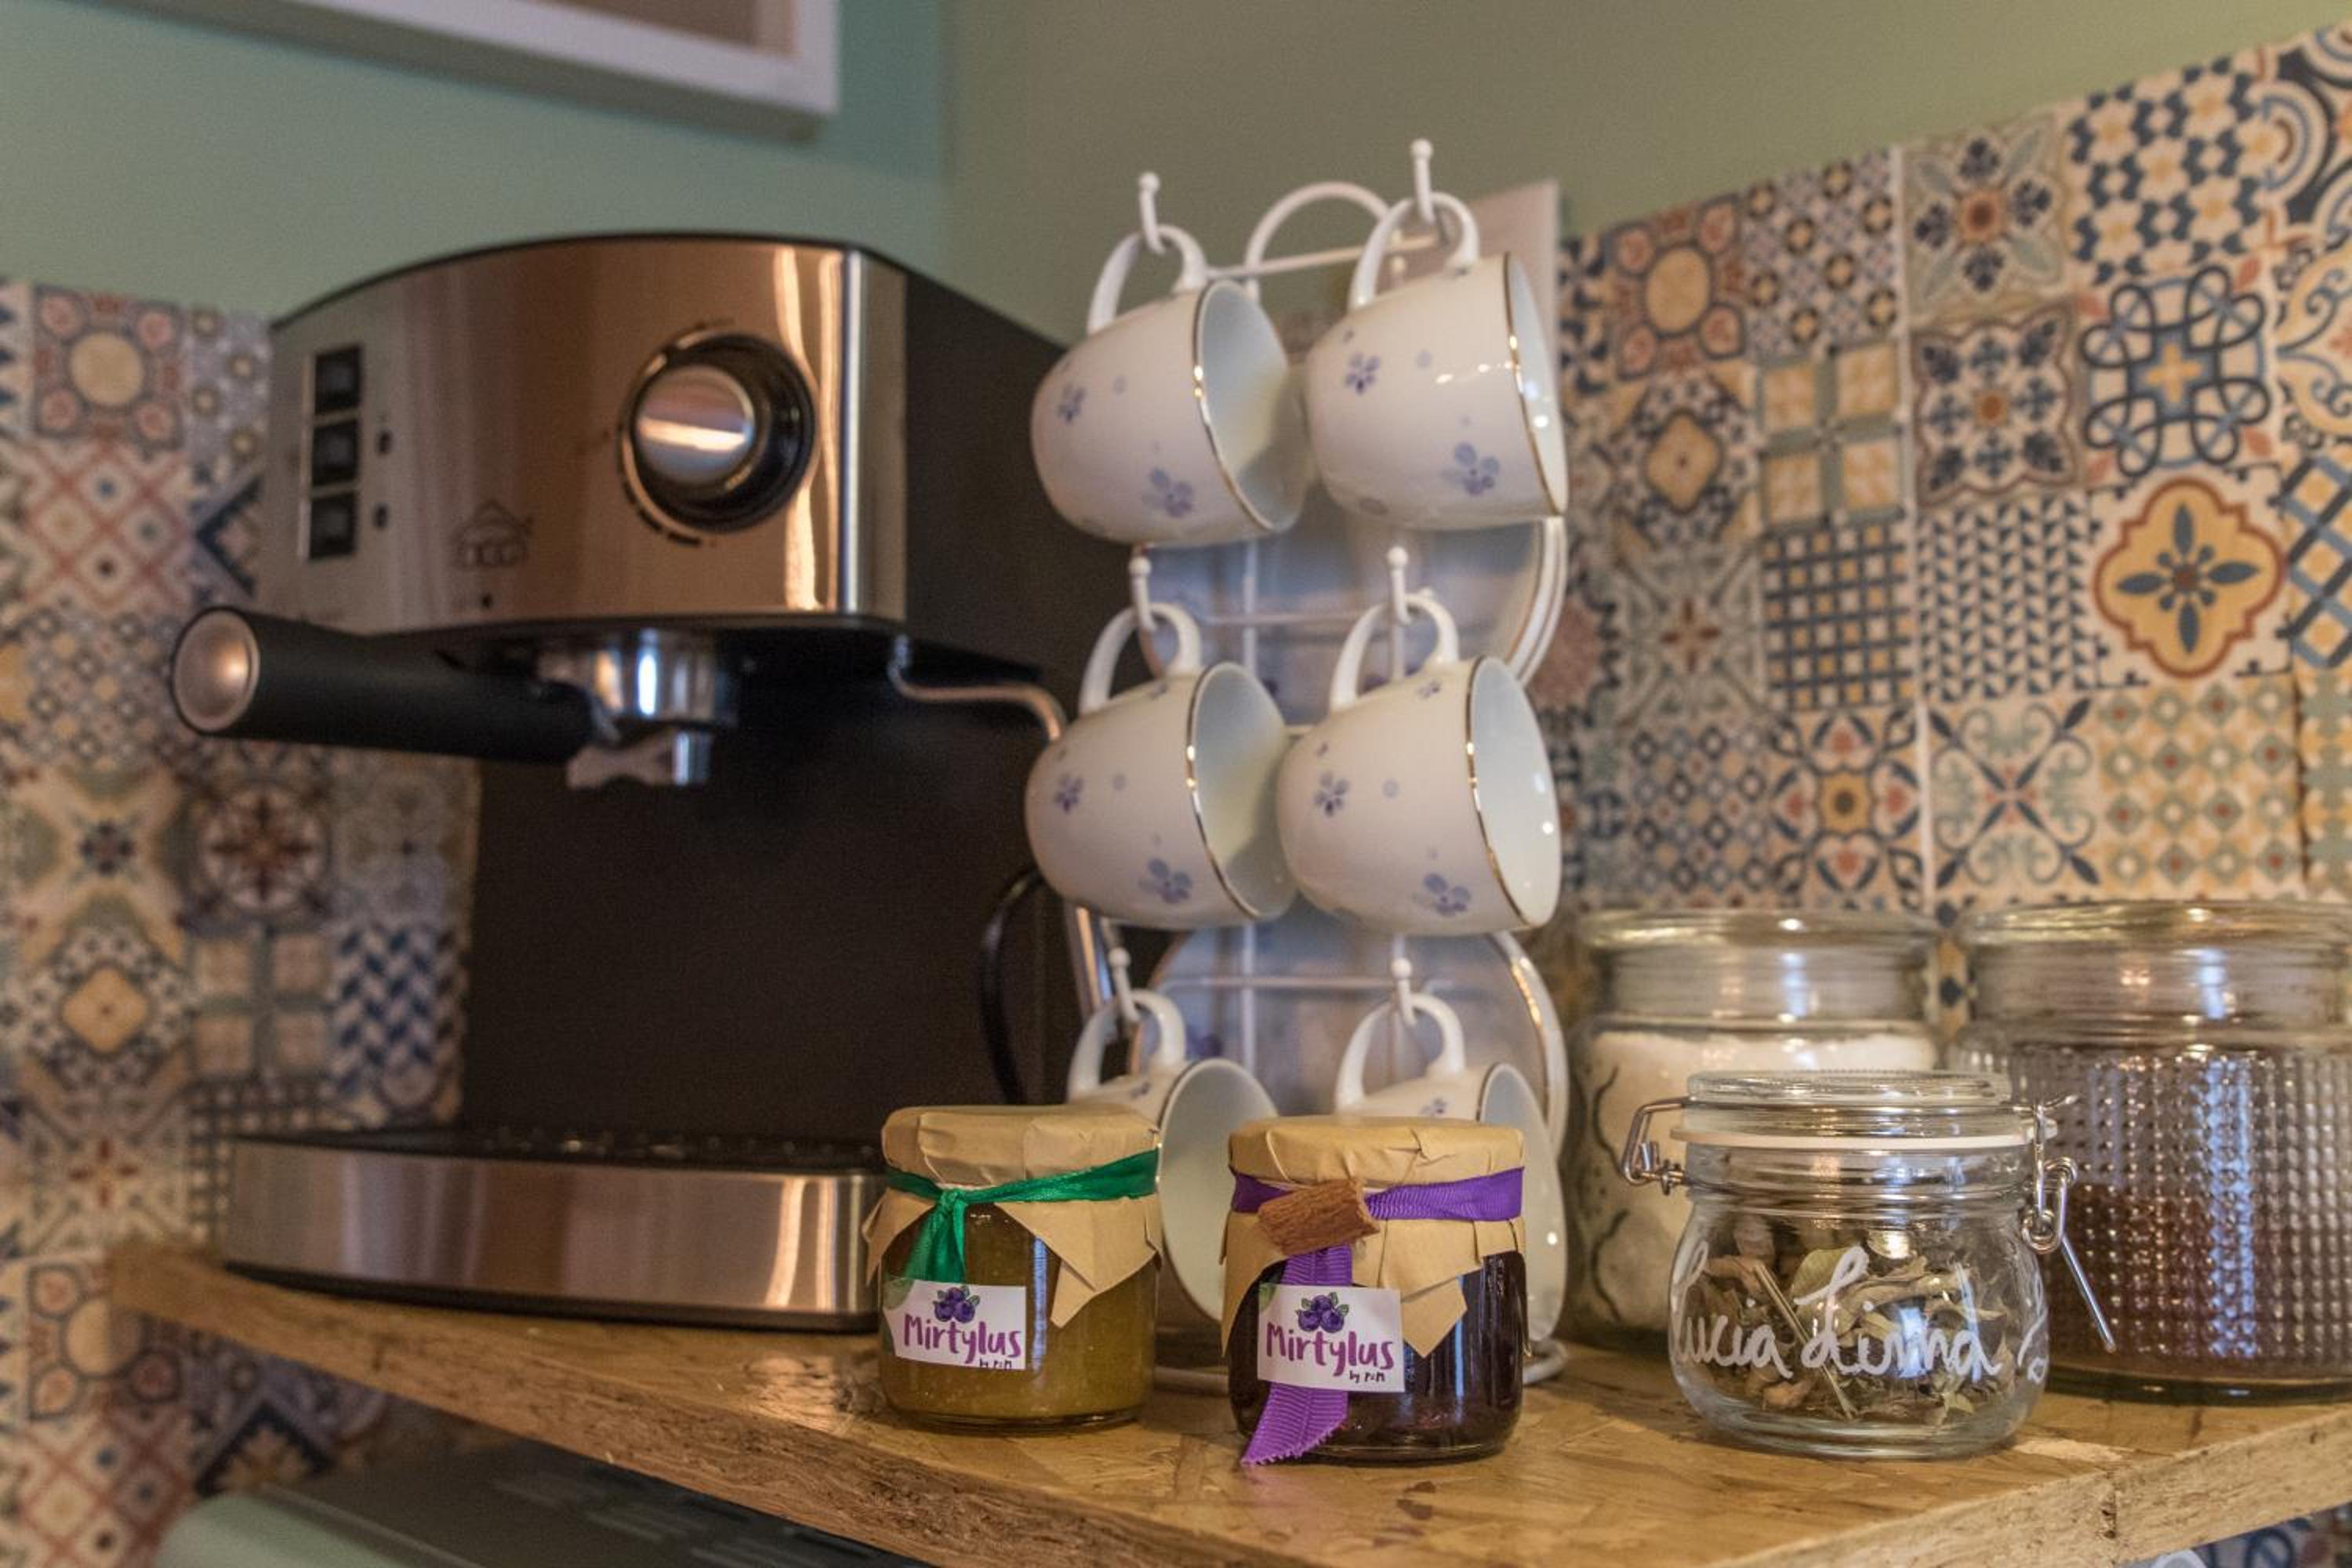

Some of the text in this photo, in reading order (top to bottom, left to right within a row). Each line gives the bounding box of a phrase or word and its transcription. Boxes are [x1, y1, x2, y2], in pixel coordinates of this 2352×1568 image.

[903, 1314, 1022, 1364] Mirtylus
[1266, 1322, 1394, 1377] Mirtylus
[1349, 1370, 1360, 1384] by
